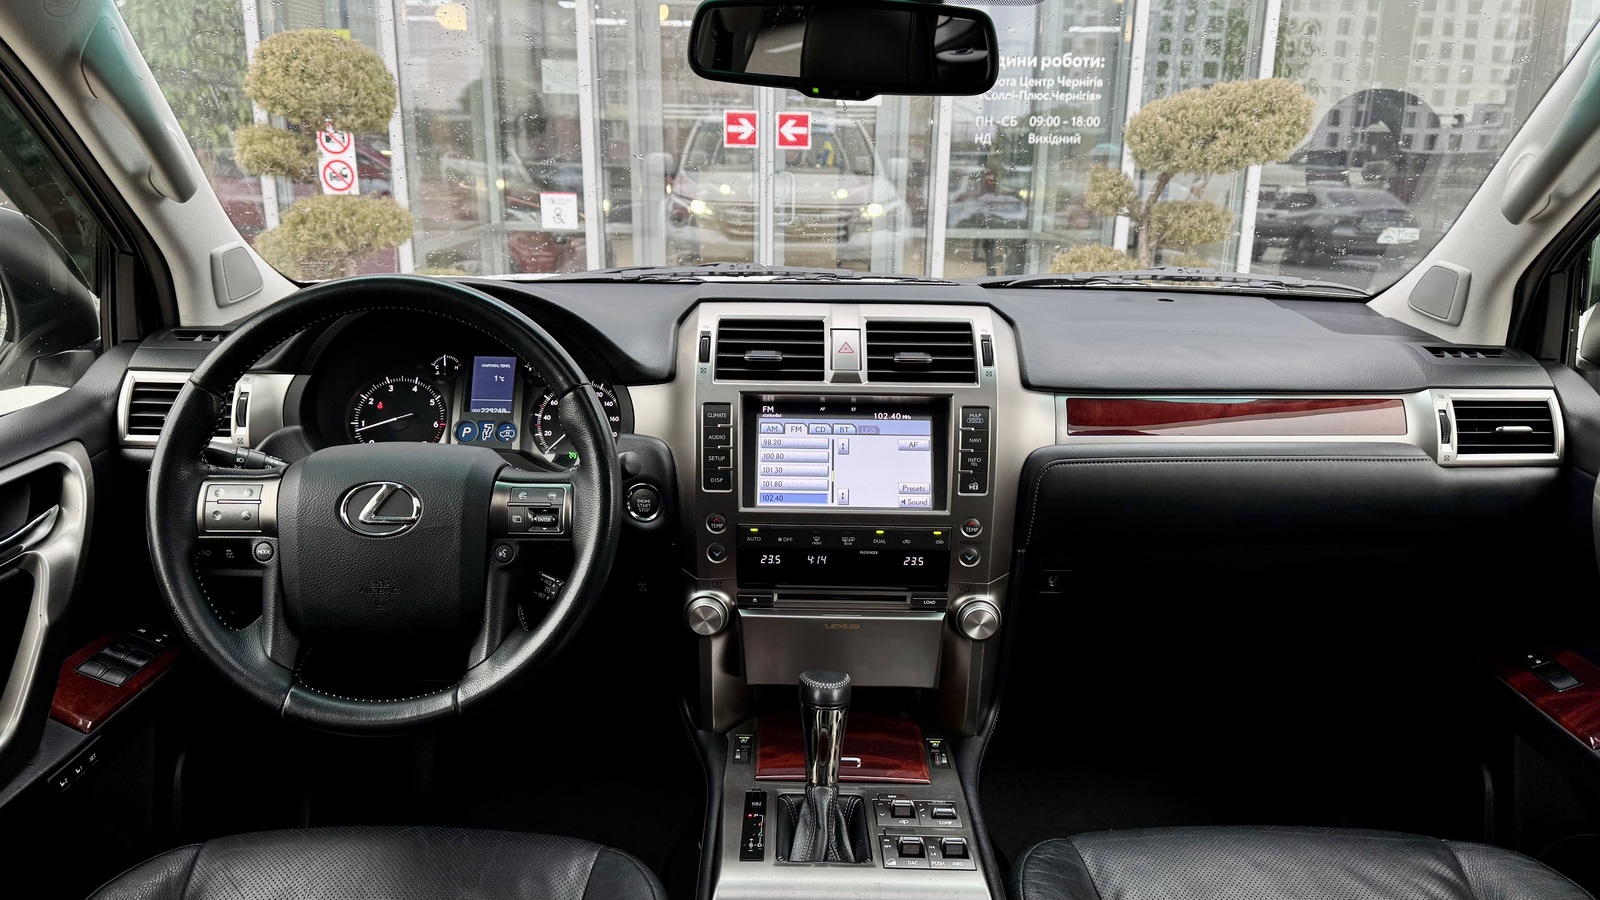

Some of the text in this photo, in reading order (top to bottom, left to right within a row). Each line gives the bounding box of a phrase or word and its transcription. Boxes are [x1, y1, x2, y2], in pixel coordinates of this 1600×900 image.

[1040, 52, 1106, 71] роботи:
[1020, 76, 1054, 89] Центр
[1056, 76, 1104, 88] Чернігів
[976, 116, 993, 127] ПН
[1028, 116, 1060, 127] 09:00
[1071, 116, 1100, 127] 18:00
[974, 133, 1082, 146] НД Вихідний
[760, 555, 781, 564] 23.5
[807, 556, 827, 564] 4:14
[903, 557, 924, 566] 23.5
